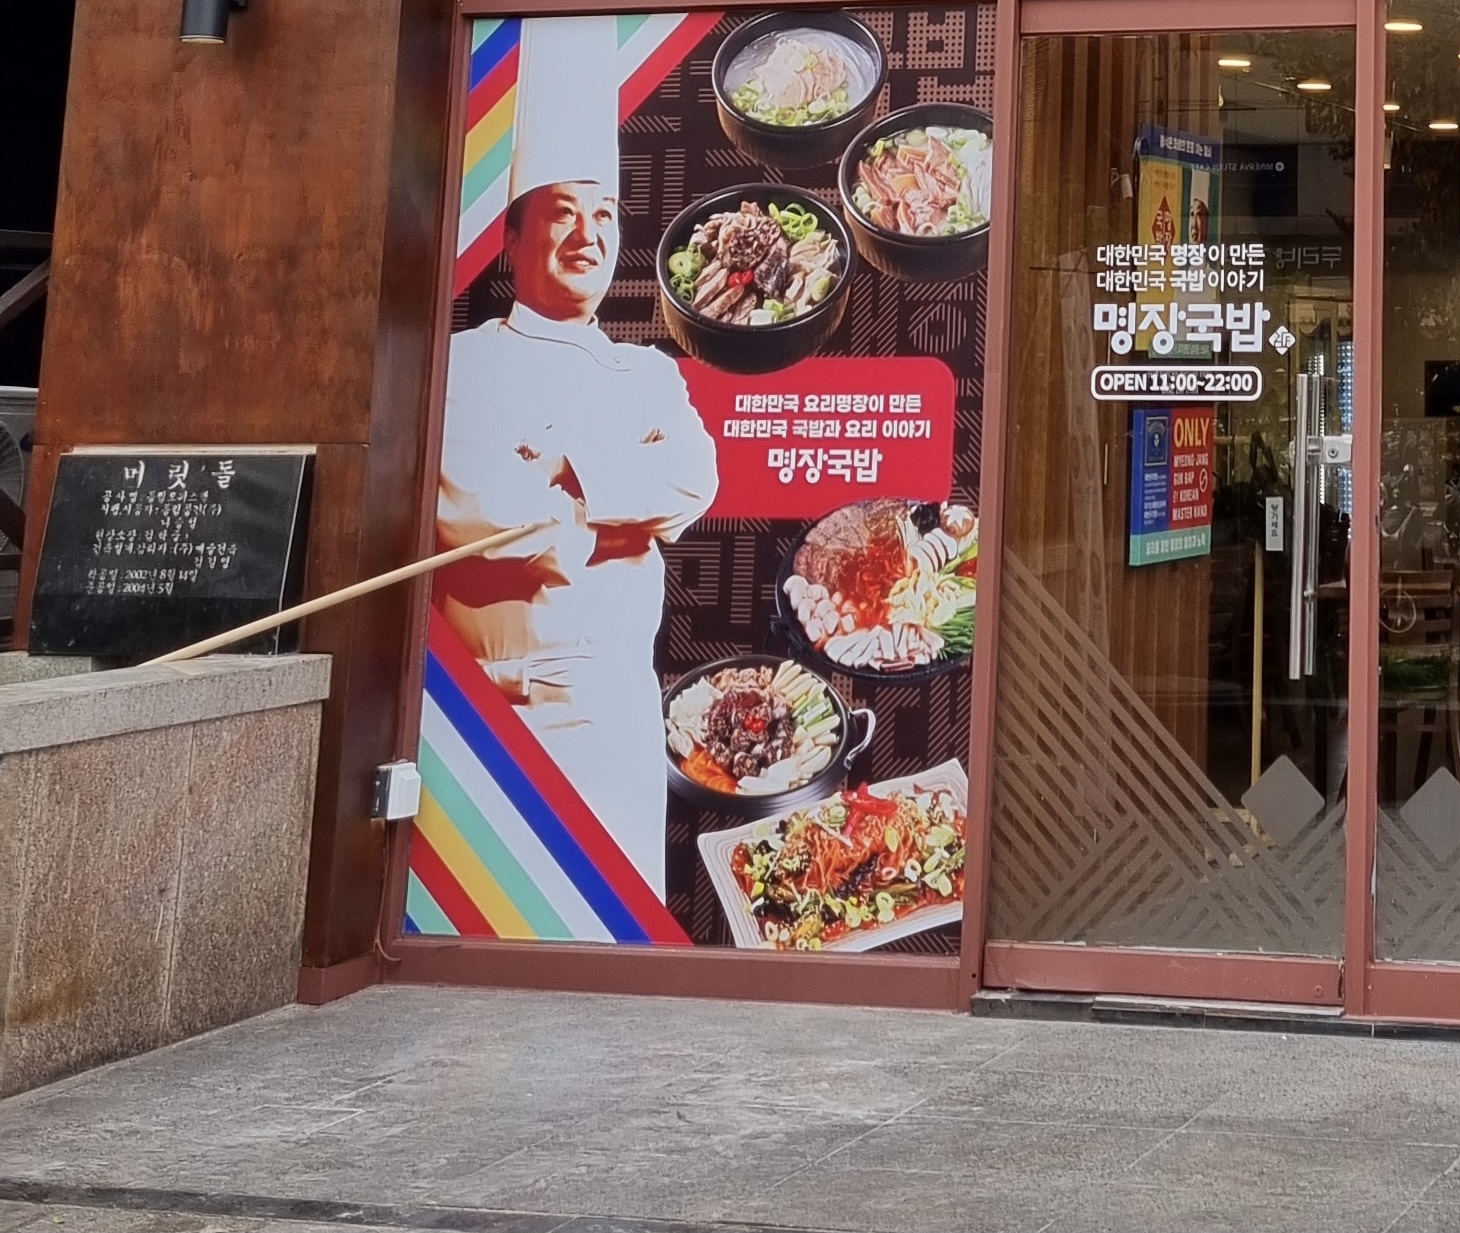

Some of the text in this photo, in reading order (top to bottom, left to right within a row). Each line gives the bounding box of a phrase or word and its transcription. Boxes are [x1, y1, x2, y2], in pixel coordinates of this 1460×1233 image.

[1096, 244, 1166, 267] 대한민국
[1229, 243, 1266, 265] 만든
[1096, 270, 1166, 293] 대한민국
[1093, 302, 1271, 355] 명장국밥
[1100, 372, 1253, 393] OPEN 11:00~22:00
[803, 394, 884, 413] 요리명장이
[889, 394, 922, 413] 만든
[723, 419, 931, 439] 대한민국 국밥과 요리 이야기
[1173, 417, 1209, 448] ONLY
[768, 448, 883, 484] 명장국밥
